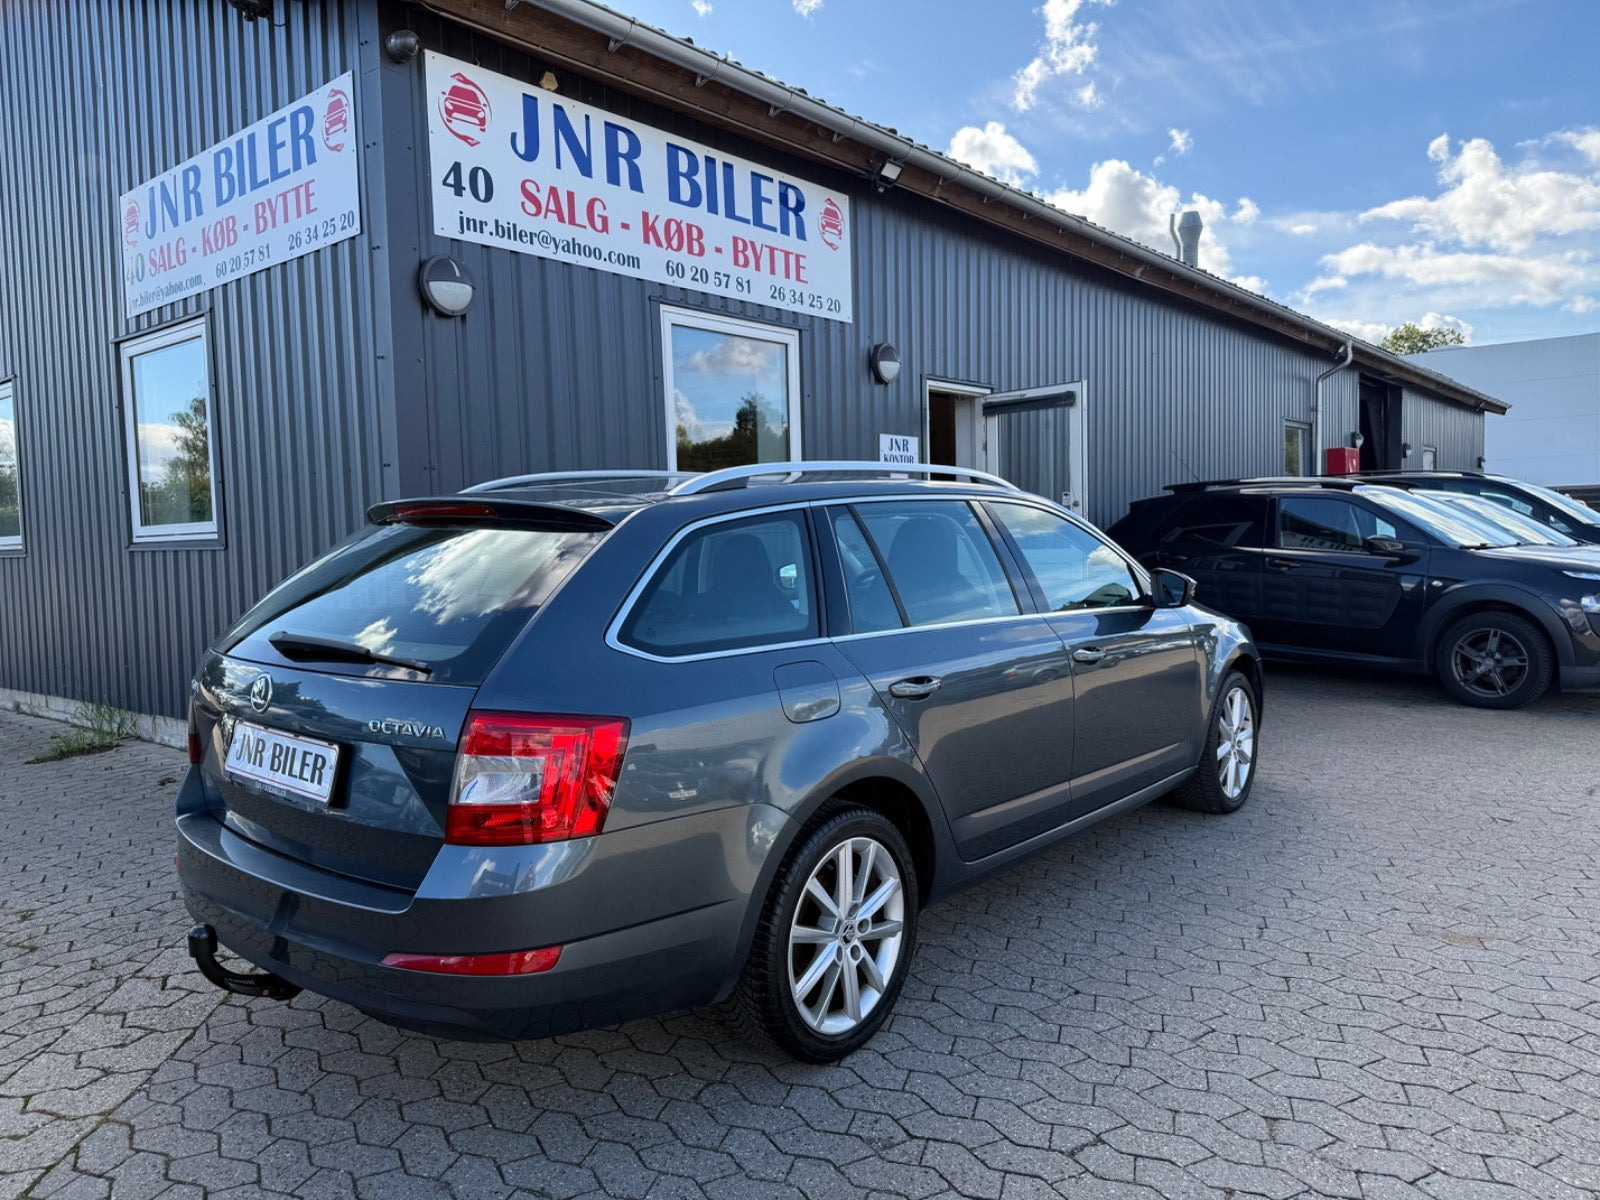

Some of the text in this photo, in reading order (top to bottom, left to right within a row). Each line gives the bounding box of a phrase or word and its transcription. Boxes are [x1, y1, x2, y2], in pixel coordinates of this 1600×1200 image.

[145, 104, 317, 240] JNR BILER
[442, 161, 494, 203] 40
[510, 92, 807, 242] JNR BILER
[149, 236, 187, 277] SALG
[201, 214, 238, 257] KØB
[254, 179, 318, 235] BYTTE
[216, 261, 227, 278] 60
[229, 255, 241, 273] 20
[244, 248, 255, 268] 57
[258, 243, 271, 261] 81
[288, 231, 302, 251] 26
[305, 224, 319, 245] 34
[322, 217, 336, 238] 25
[340, 210, 355, 232] 20
[520, 178, 609, 235] SALG
[642, 210, 705, 257] KØB
[732, 235, 808, 285] BYTTE
[126, 252, 145, 285] 40
[457, 210, 841, 313] jnr.biler@yahoo.com 60 20 57 81 26 34 25 20
[884, 454, 914, 464] KONTOR
[889, 437, 909, 452] JNR
[368, 719, 446, 739] OCTAVIA
[235, 733, 327, 786] JNR BILER
